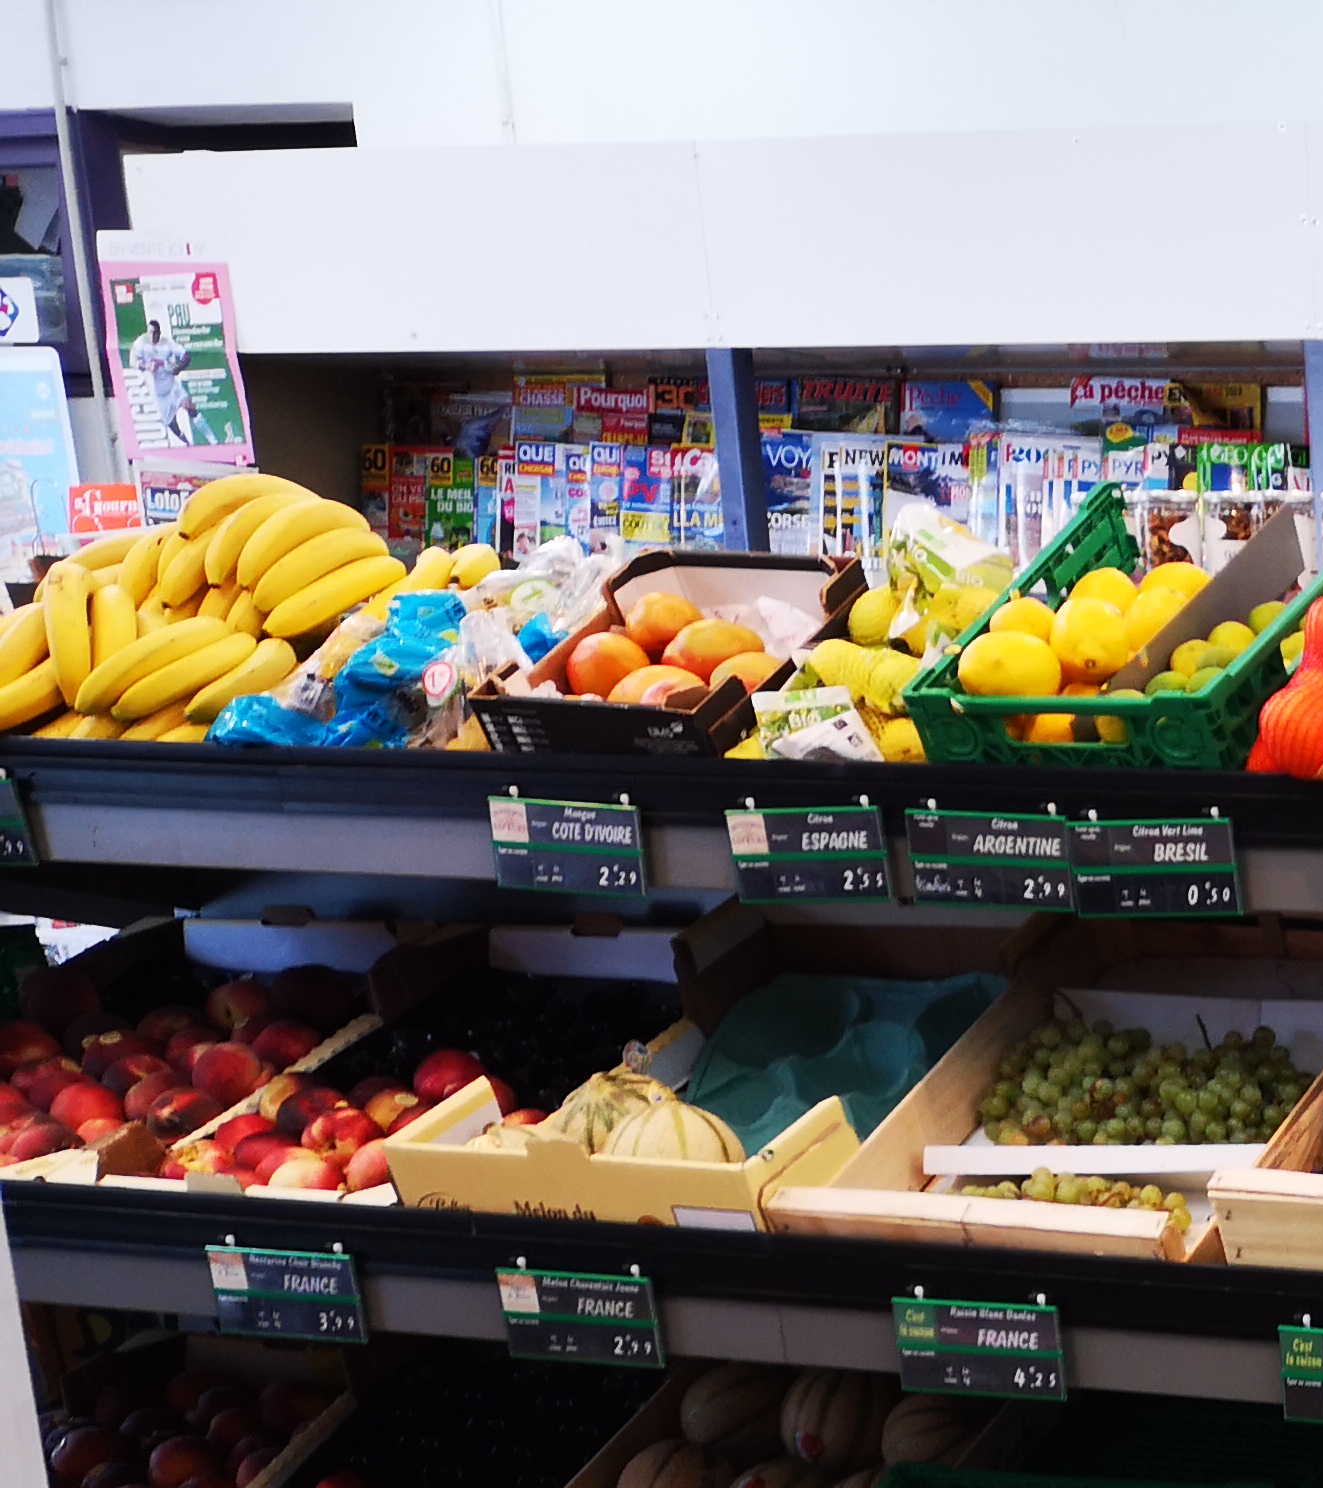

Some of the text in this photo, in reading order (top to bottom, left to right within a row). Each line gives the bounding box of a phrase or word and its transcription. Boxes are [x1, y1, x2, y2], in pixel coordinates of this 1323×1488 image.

[580, 387, 648, 411] Pourquoi
[803, 381, 893, 402] TRUITE
[518, 442, 555, 463] QUE
[430, 457, 451, 474] 60
[552, 821, 581, 841] COTE
[801, 831, 868, 850] ESPAGNE
[973, 834, 1061, 857] ARGENTINE
[1153, 842, 1209, 862] BRESIL
[284, 1273, 339, 1295] FRANCE
[577, 1297, 634, 1318] FRANCE
[977, 1328, 1039, 1350] FRANCE
